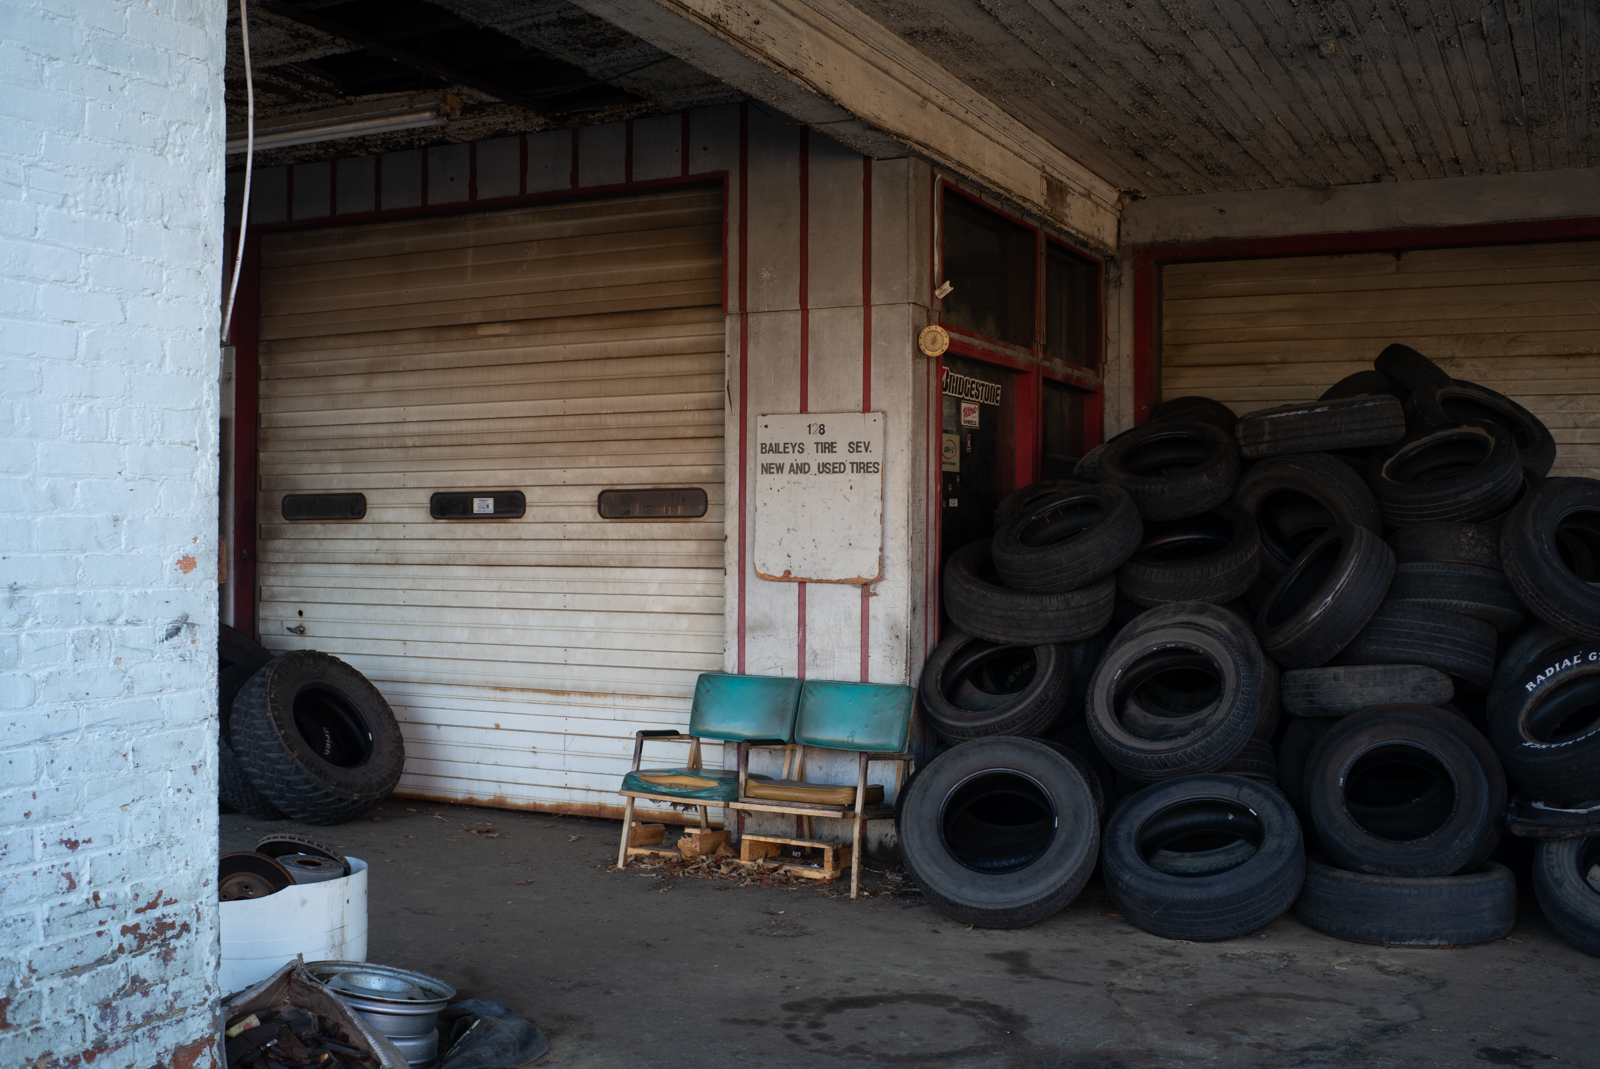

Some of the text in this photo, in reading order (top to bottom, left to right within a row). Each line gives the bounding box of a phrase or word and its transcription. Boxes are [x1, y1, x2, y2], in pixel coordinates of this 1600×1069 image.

[942, 367, 1001, 406] BRIDGESTONE
[760, 441, 872, 454] BAILEYS TIRE SEV.
[761, 461, 880, 475] NEW AND USED TIRES
[1524, 651, 1600, 692] RADIAL G
